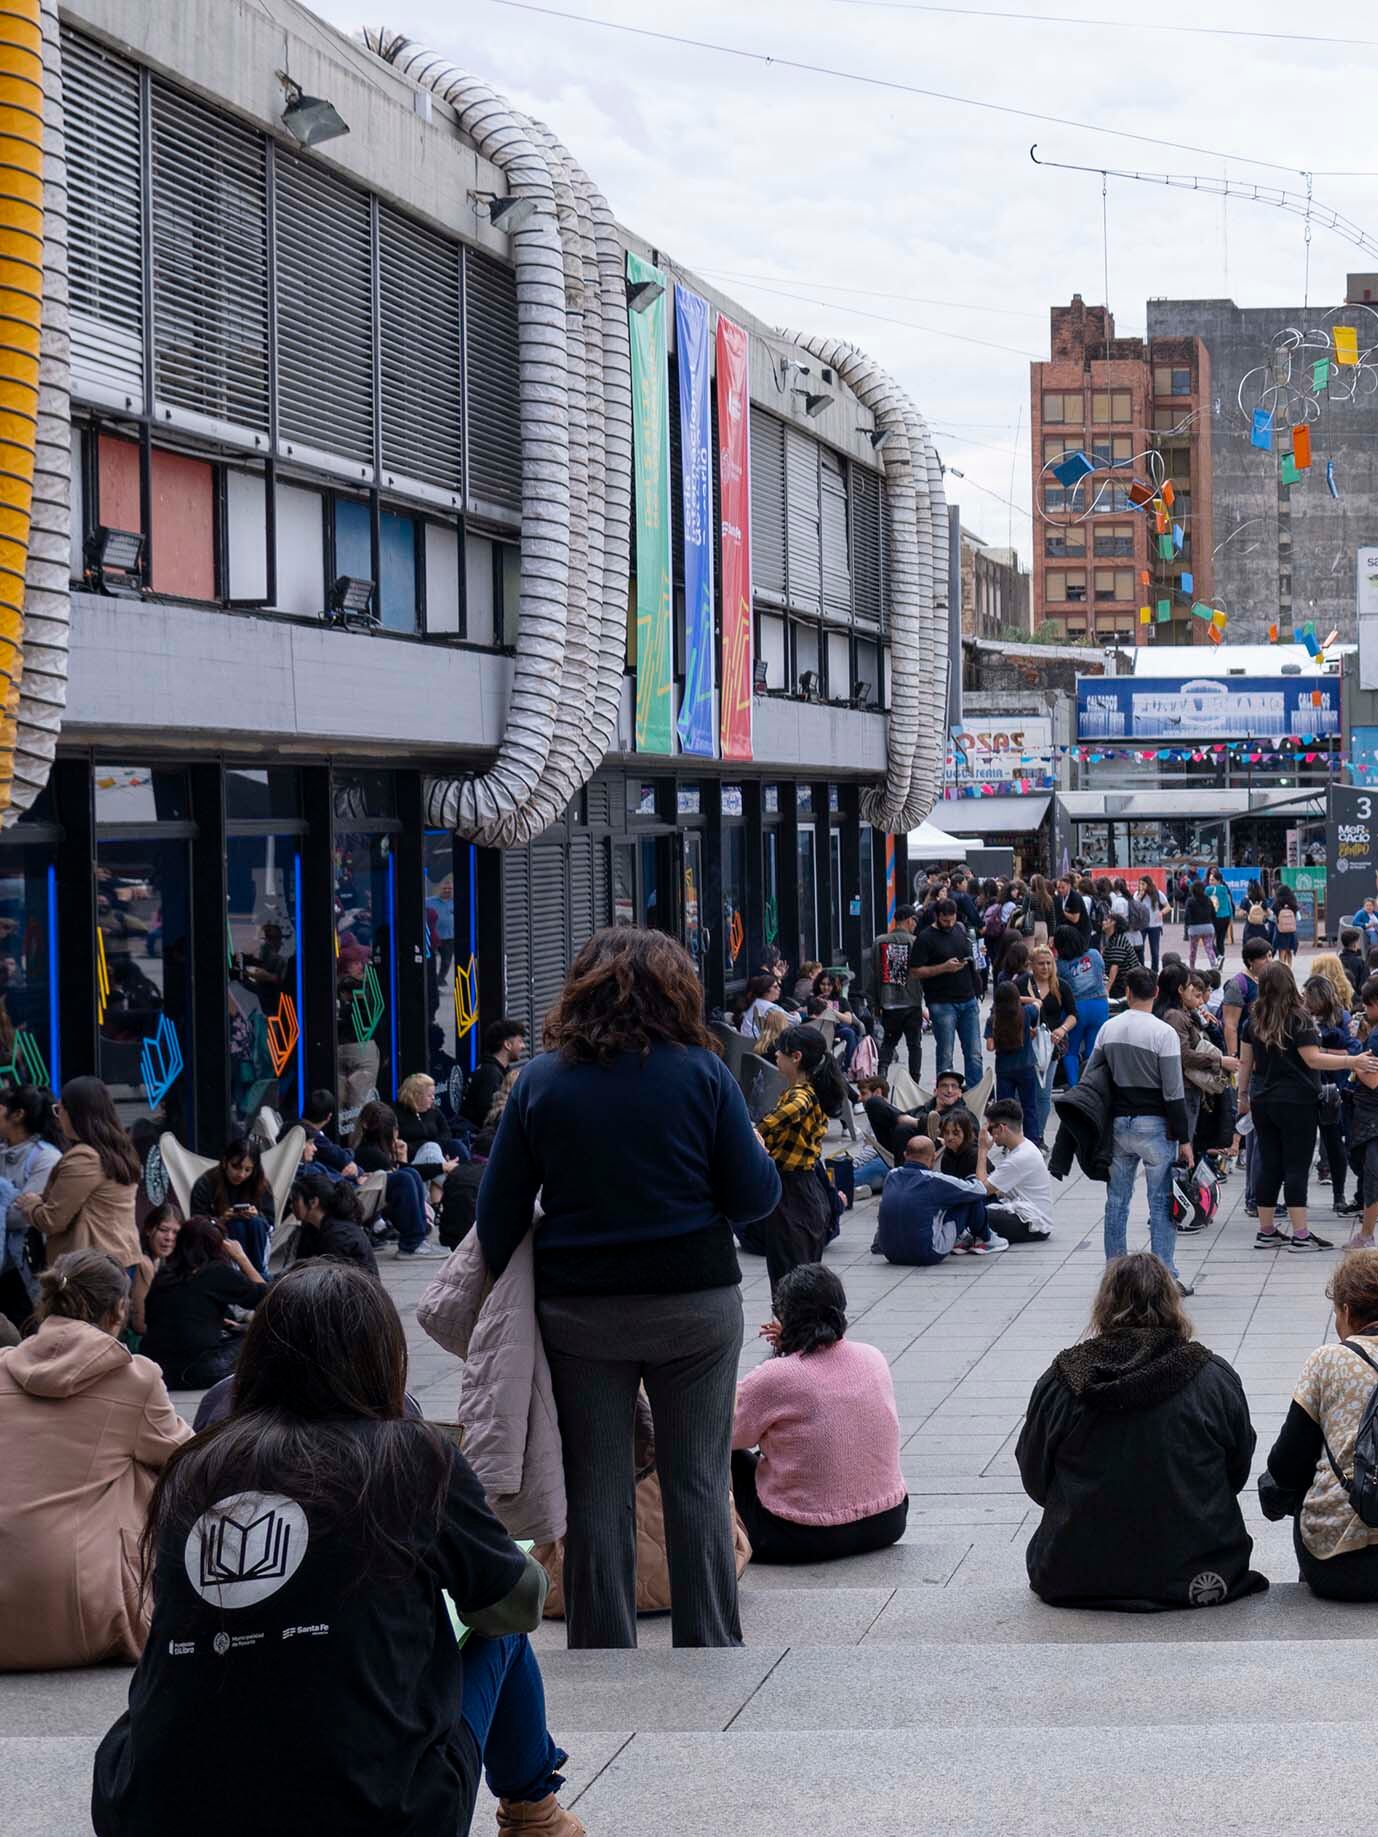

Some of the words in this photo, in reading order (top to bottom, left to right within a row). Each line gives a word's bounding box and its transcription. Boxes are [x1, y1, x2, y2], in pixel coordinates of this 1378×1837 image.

[1356, 797, 1372, 820] 3
[297, 1625, 319, 1634] Santa
[319, 1624, 329, 1632] Fe
